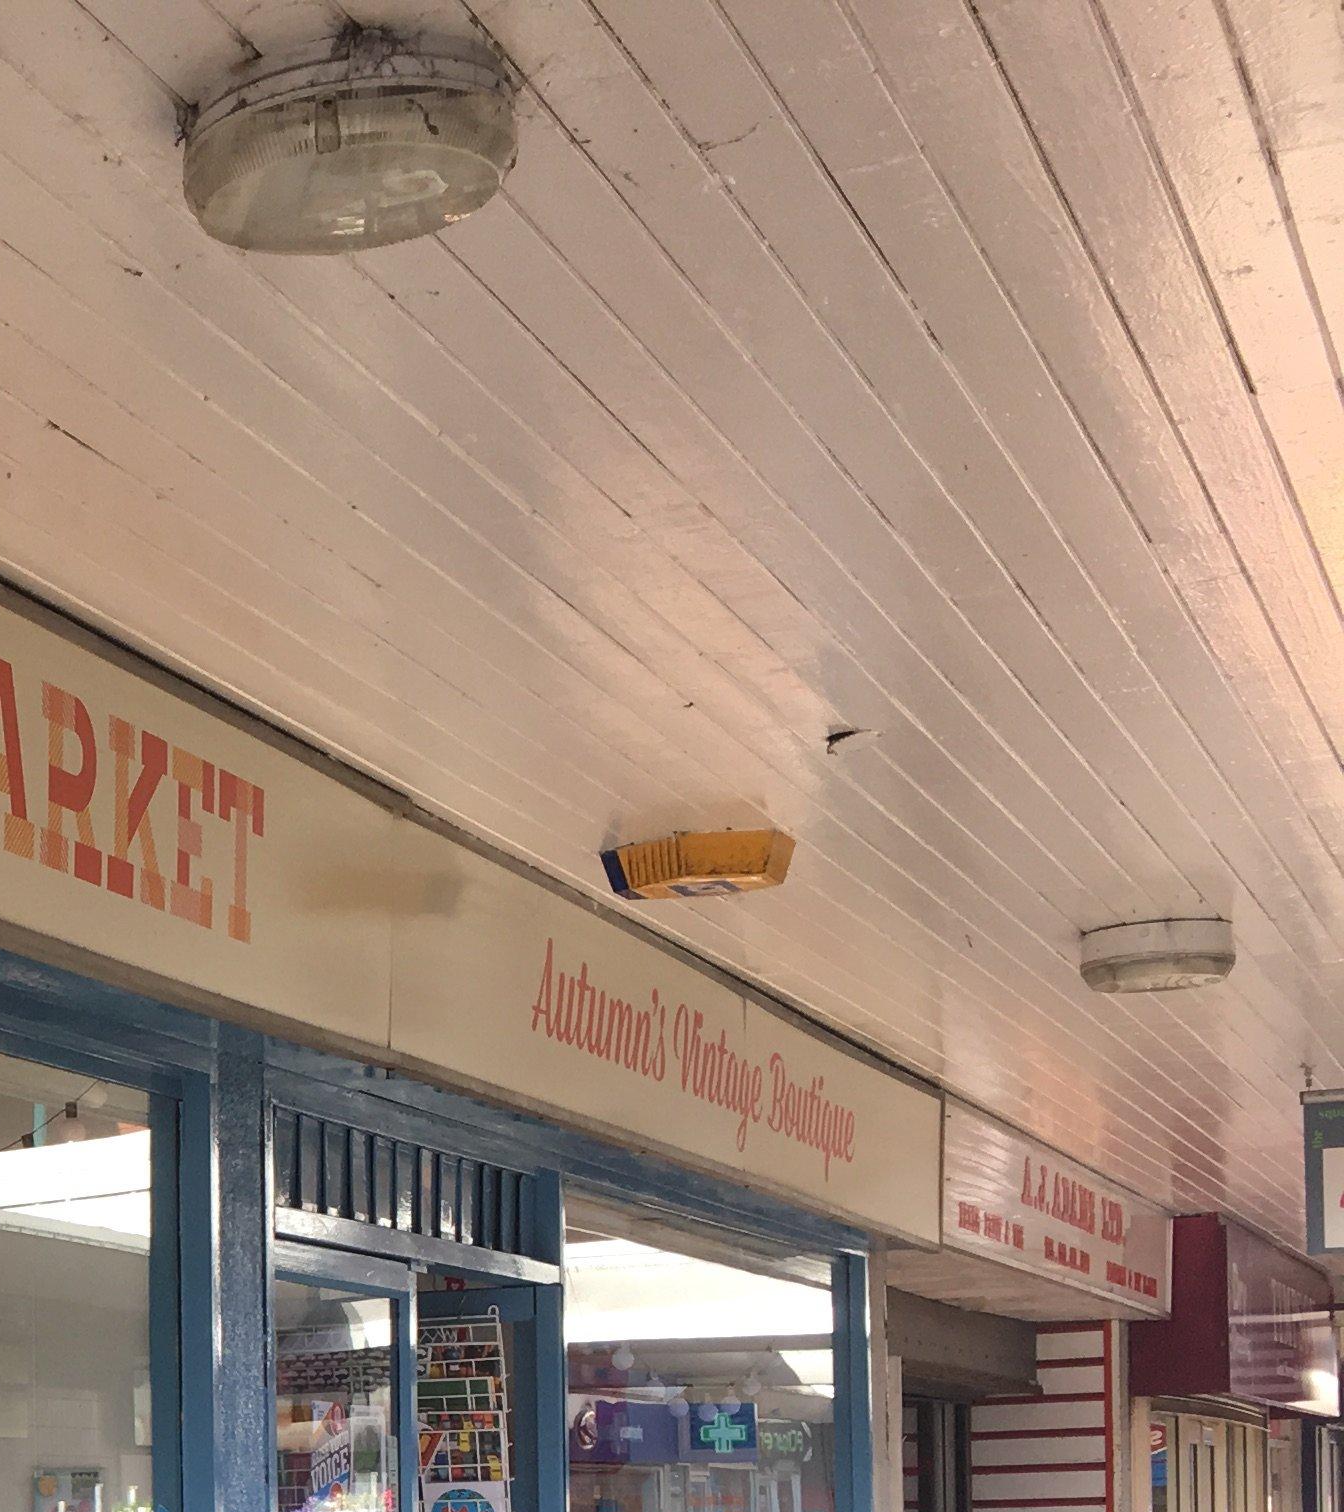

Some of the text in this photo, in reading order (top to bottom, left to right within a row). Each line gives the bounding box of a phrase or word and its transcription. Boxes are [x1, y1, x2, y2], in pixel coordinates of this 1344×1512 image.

[531, 937, 856, 1182] Autumn's Vintage Boutique
[310, 1446, 350, 1494] VOICE
